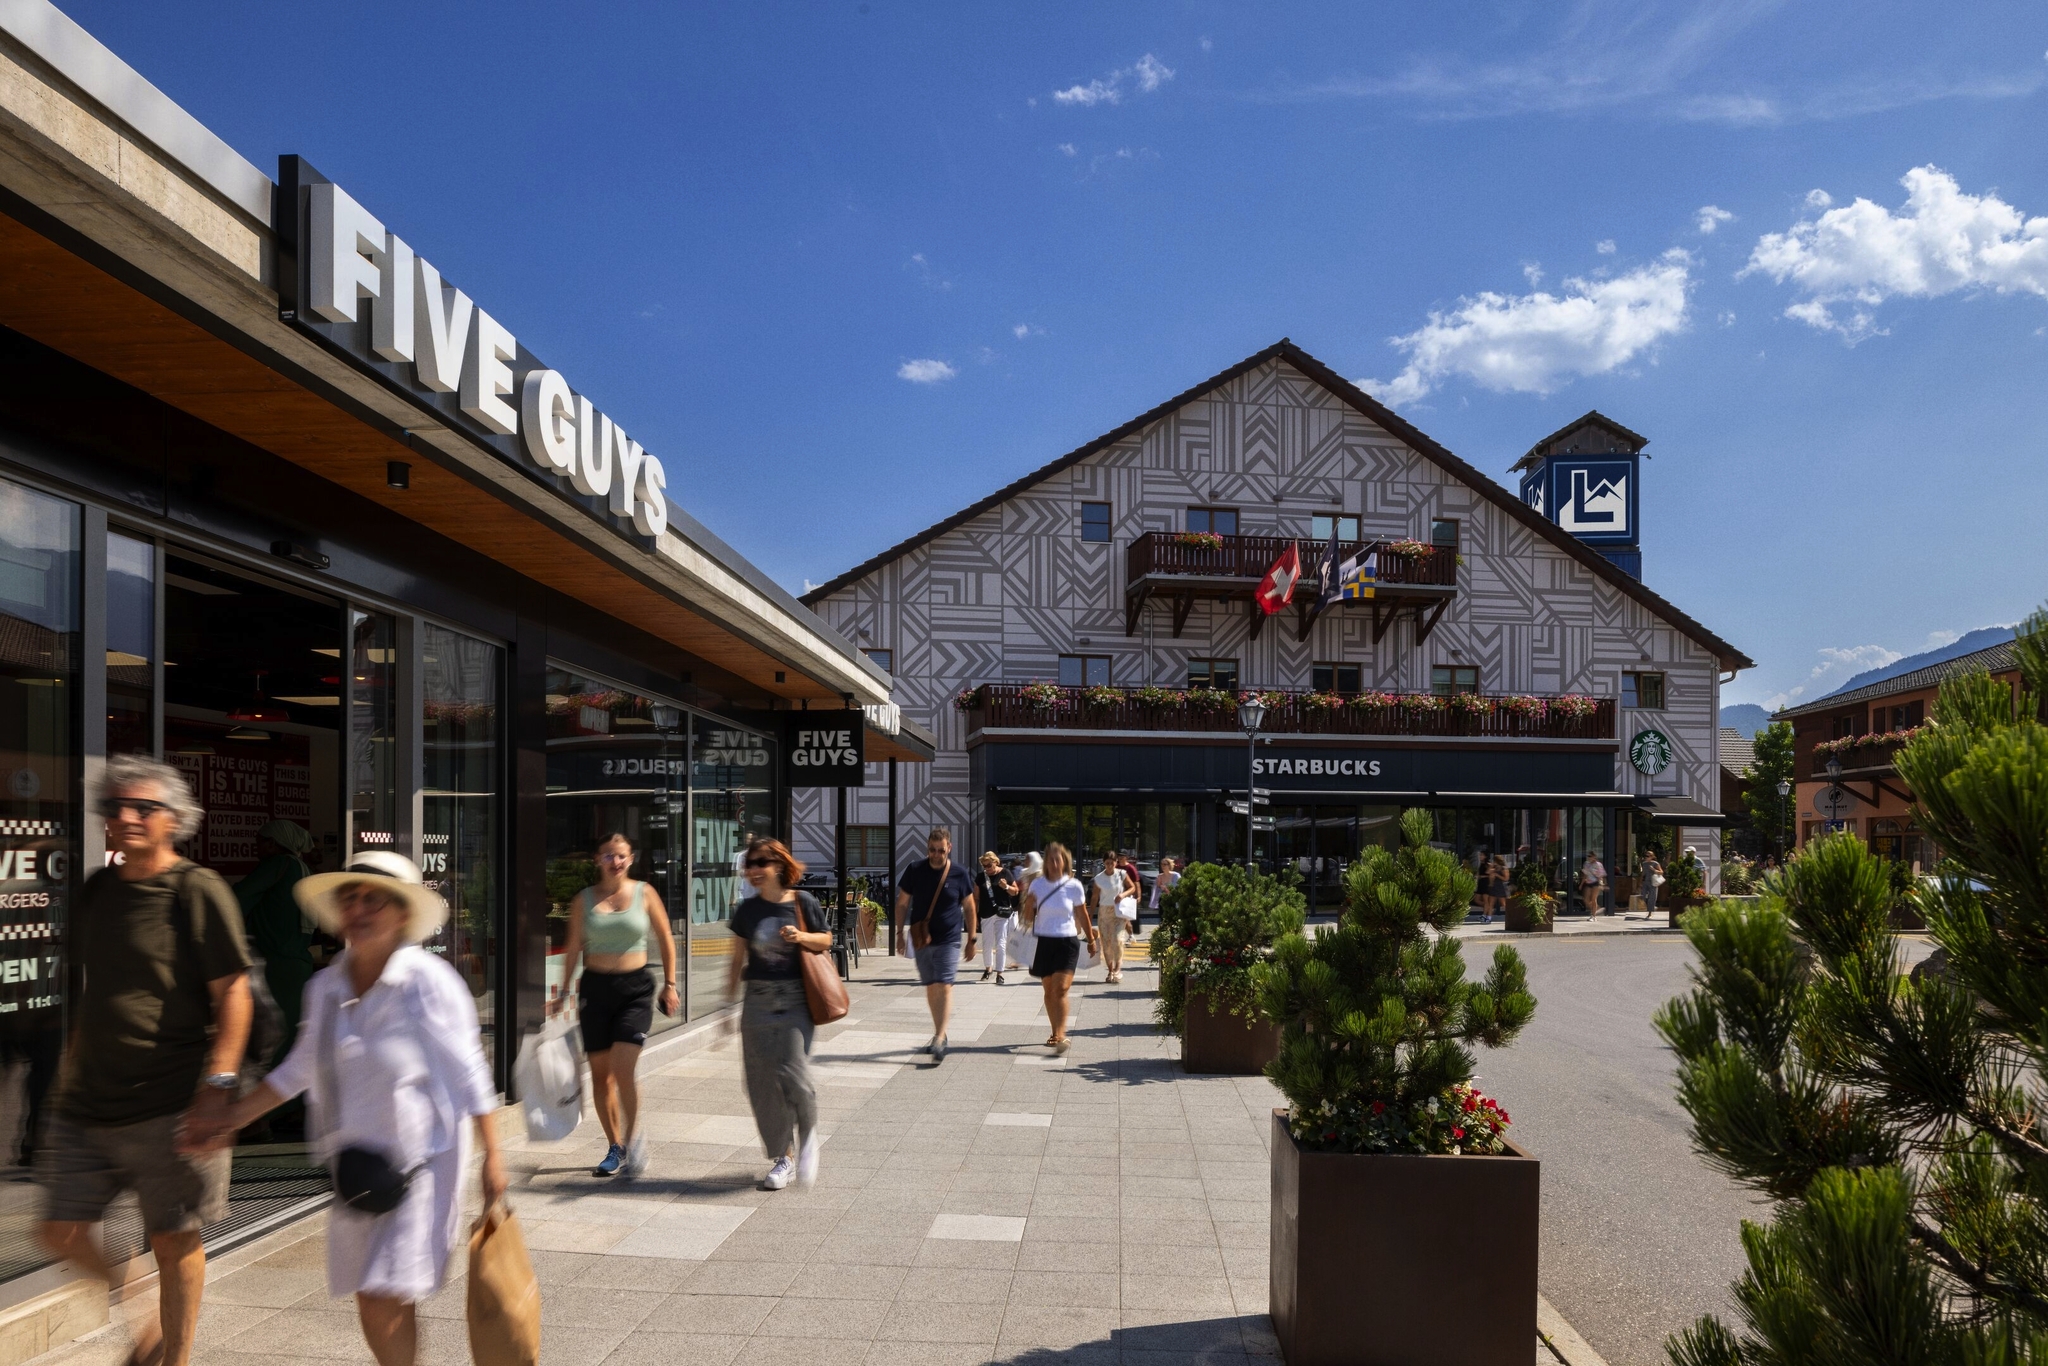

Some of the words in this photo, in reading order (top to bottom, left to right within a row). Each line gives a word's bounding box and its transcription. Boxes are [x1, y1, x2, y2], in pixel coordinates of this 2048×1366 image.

[311, 183, 518, 435] FIVE
[522, 369, 668, 536] GUYS
[798, 730, 851, 748] FIVE
[169, 755, 191, 766] ISN'T
[194, 758, 200, 768] A
[209, 755, 236, 770] FIVE
[238, 757, 269, 773] GUYS
[791, 748, 858, 766] GUYS
[275, 768, 295, 779] THIS
[298, 770, 306, 780] IS
[1252, 758, 1381, 776] STARBUCKS
[209, 770, 228, 791] IS
[232, 772, 268, 794] THE
[209, 791, 239, 805] REAL
[241, 793, 268, 807] DEAL
[210, 814, 242, 825] VOTED
[245, 816, 268, 825] BEST
[696, 817, 740, 863] FIVE
[0, 957, 38, 984] EN
[45, 956, 60, 978] 7
